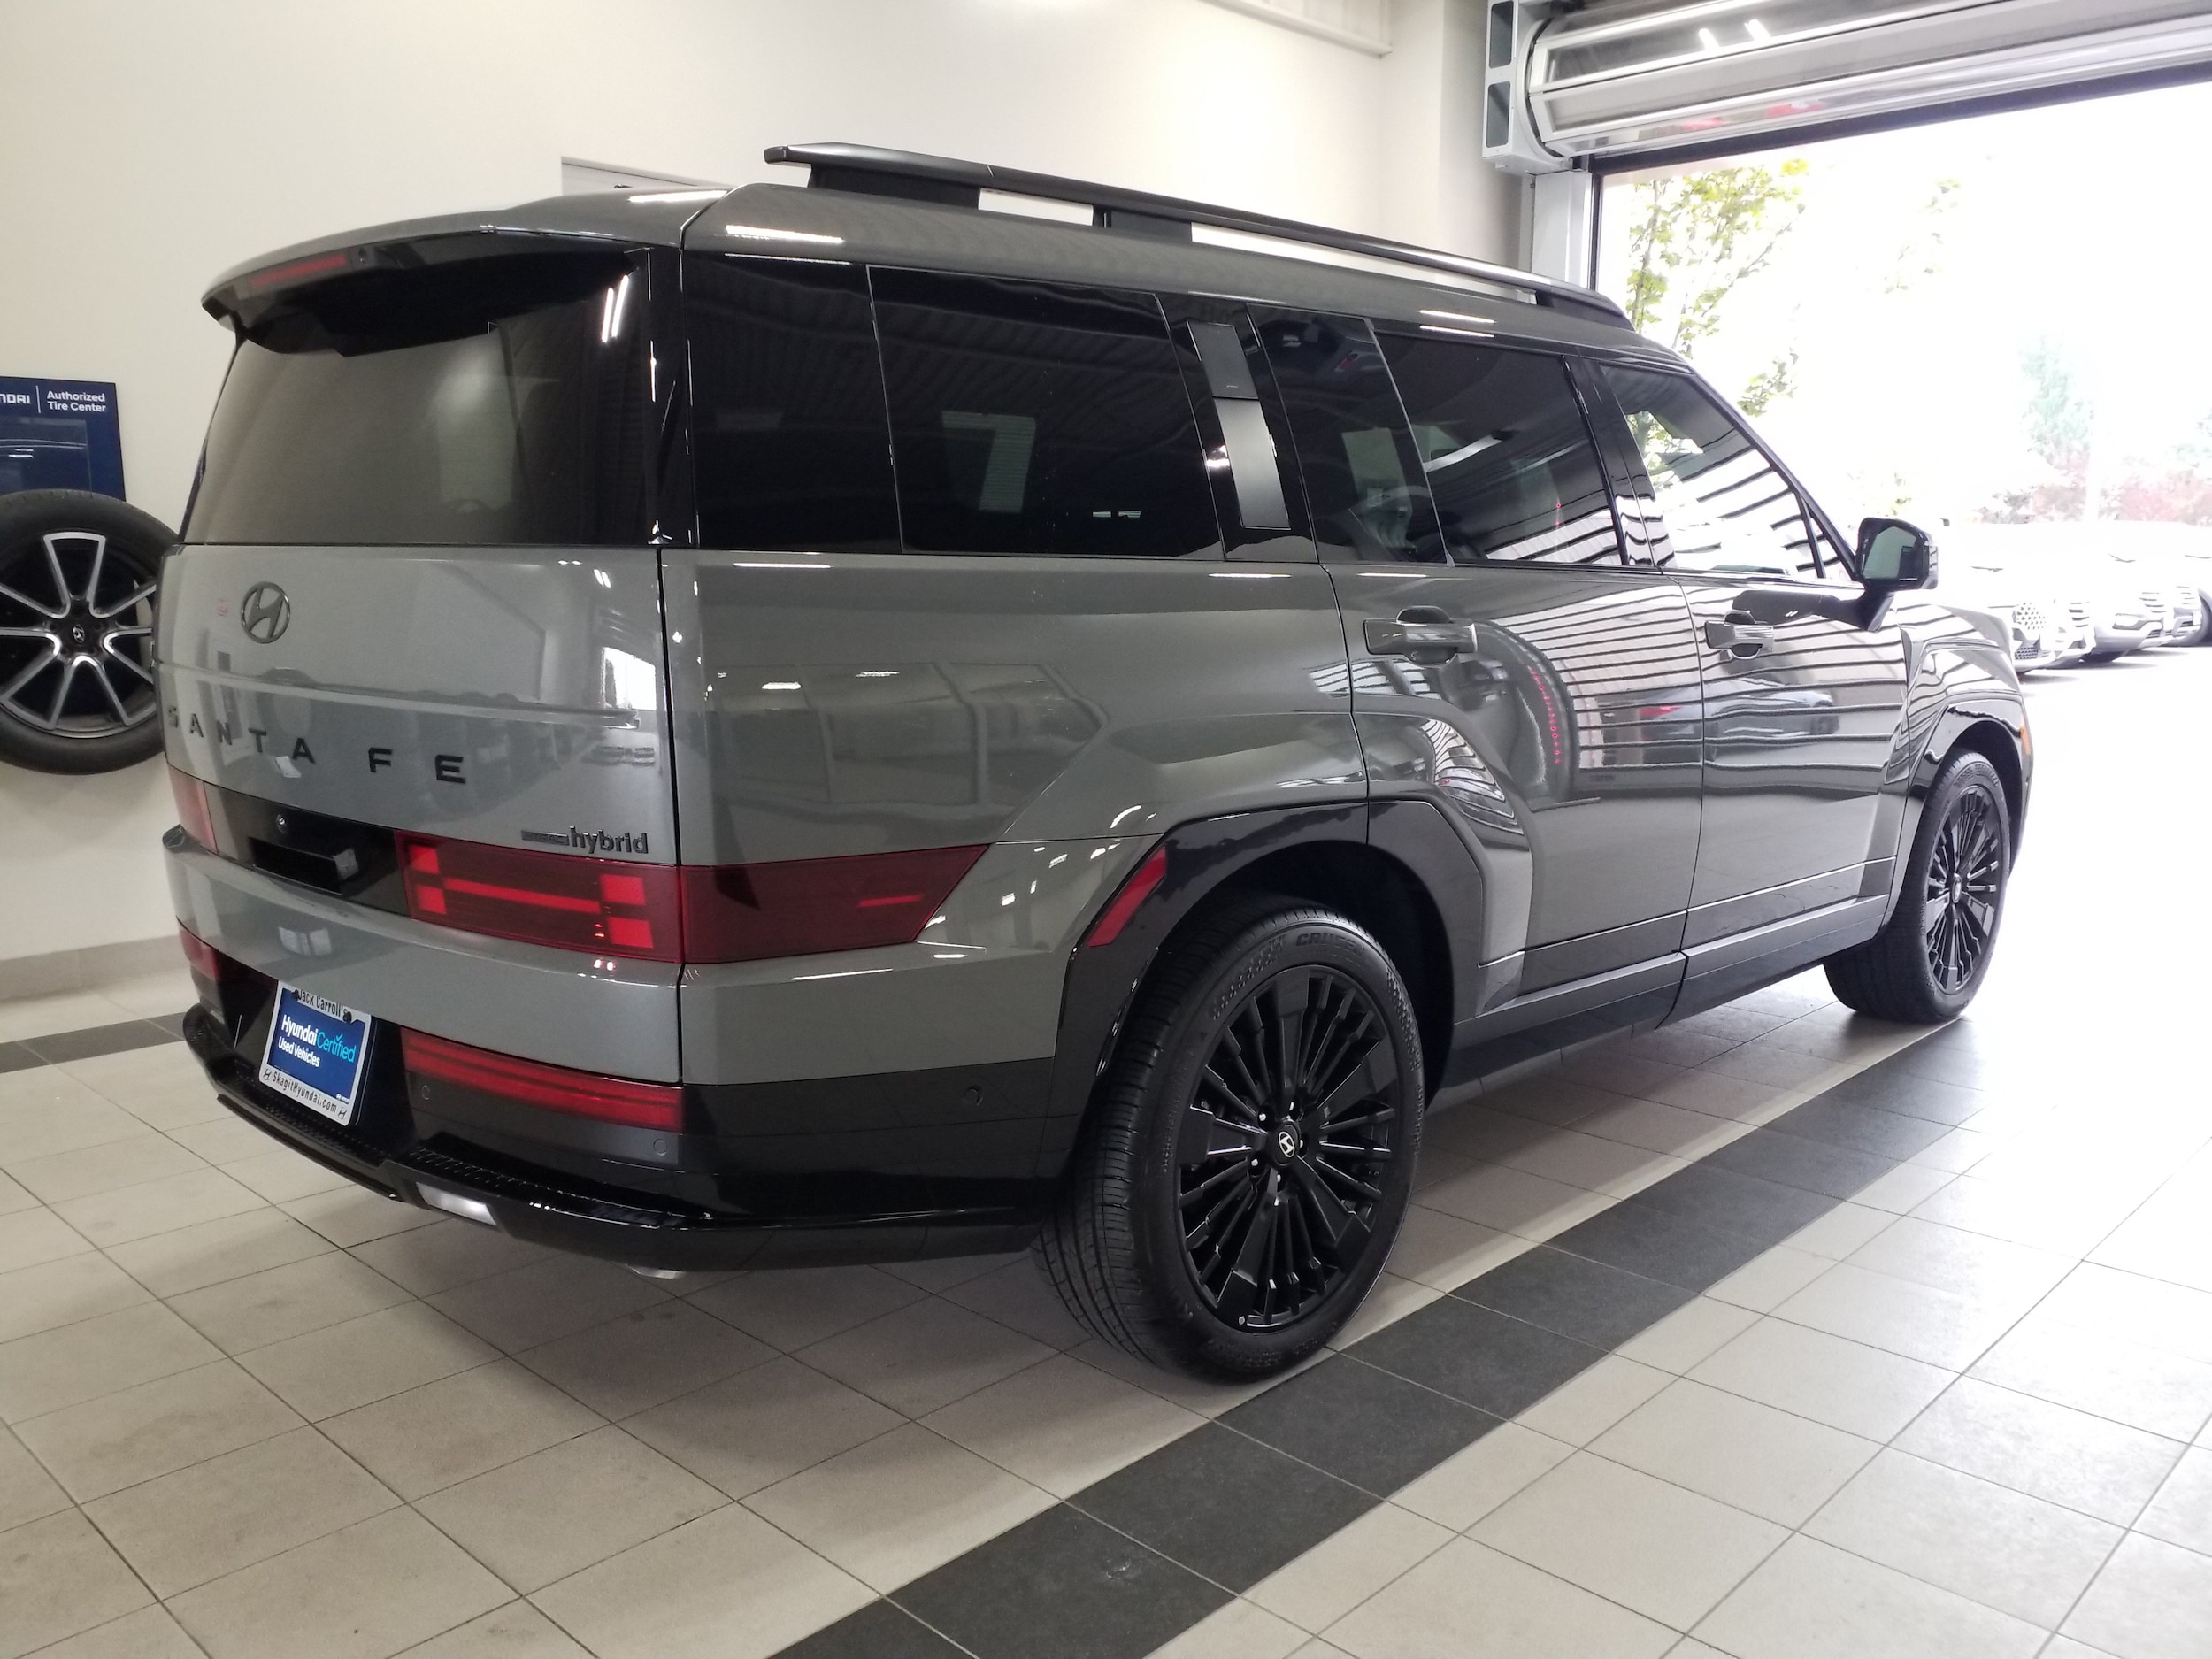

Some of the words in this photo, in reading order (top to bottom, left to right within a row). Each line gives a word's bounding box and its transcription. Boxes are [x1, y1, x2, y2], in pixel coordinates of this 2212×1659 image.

[47, 390, 106, 403] Authorized
[47, 401, 69, 411] Tire
[70, 403, 106, 412] Center
[167, 706, 317, 765] SANTA
[368, 746, 466, 784] FE
[569, 826, 649, 854] hybrid
[297, 990, 314, 1006] Jack
[278, 1036, 295, 1055] Used
[294, 1044, 321, 1068] Vehicles
[281, 1015, 319, 1046] Hyundai
[316, 1031, 357, 1063] Certified
[272, 1071, 337, 1113] SkagitHyundai.com
